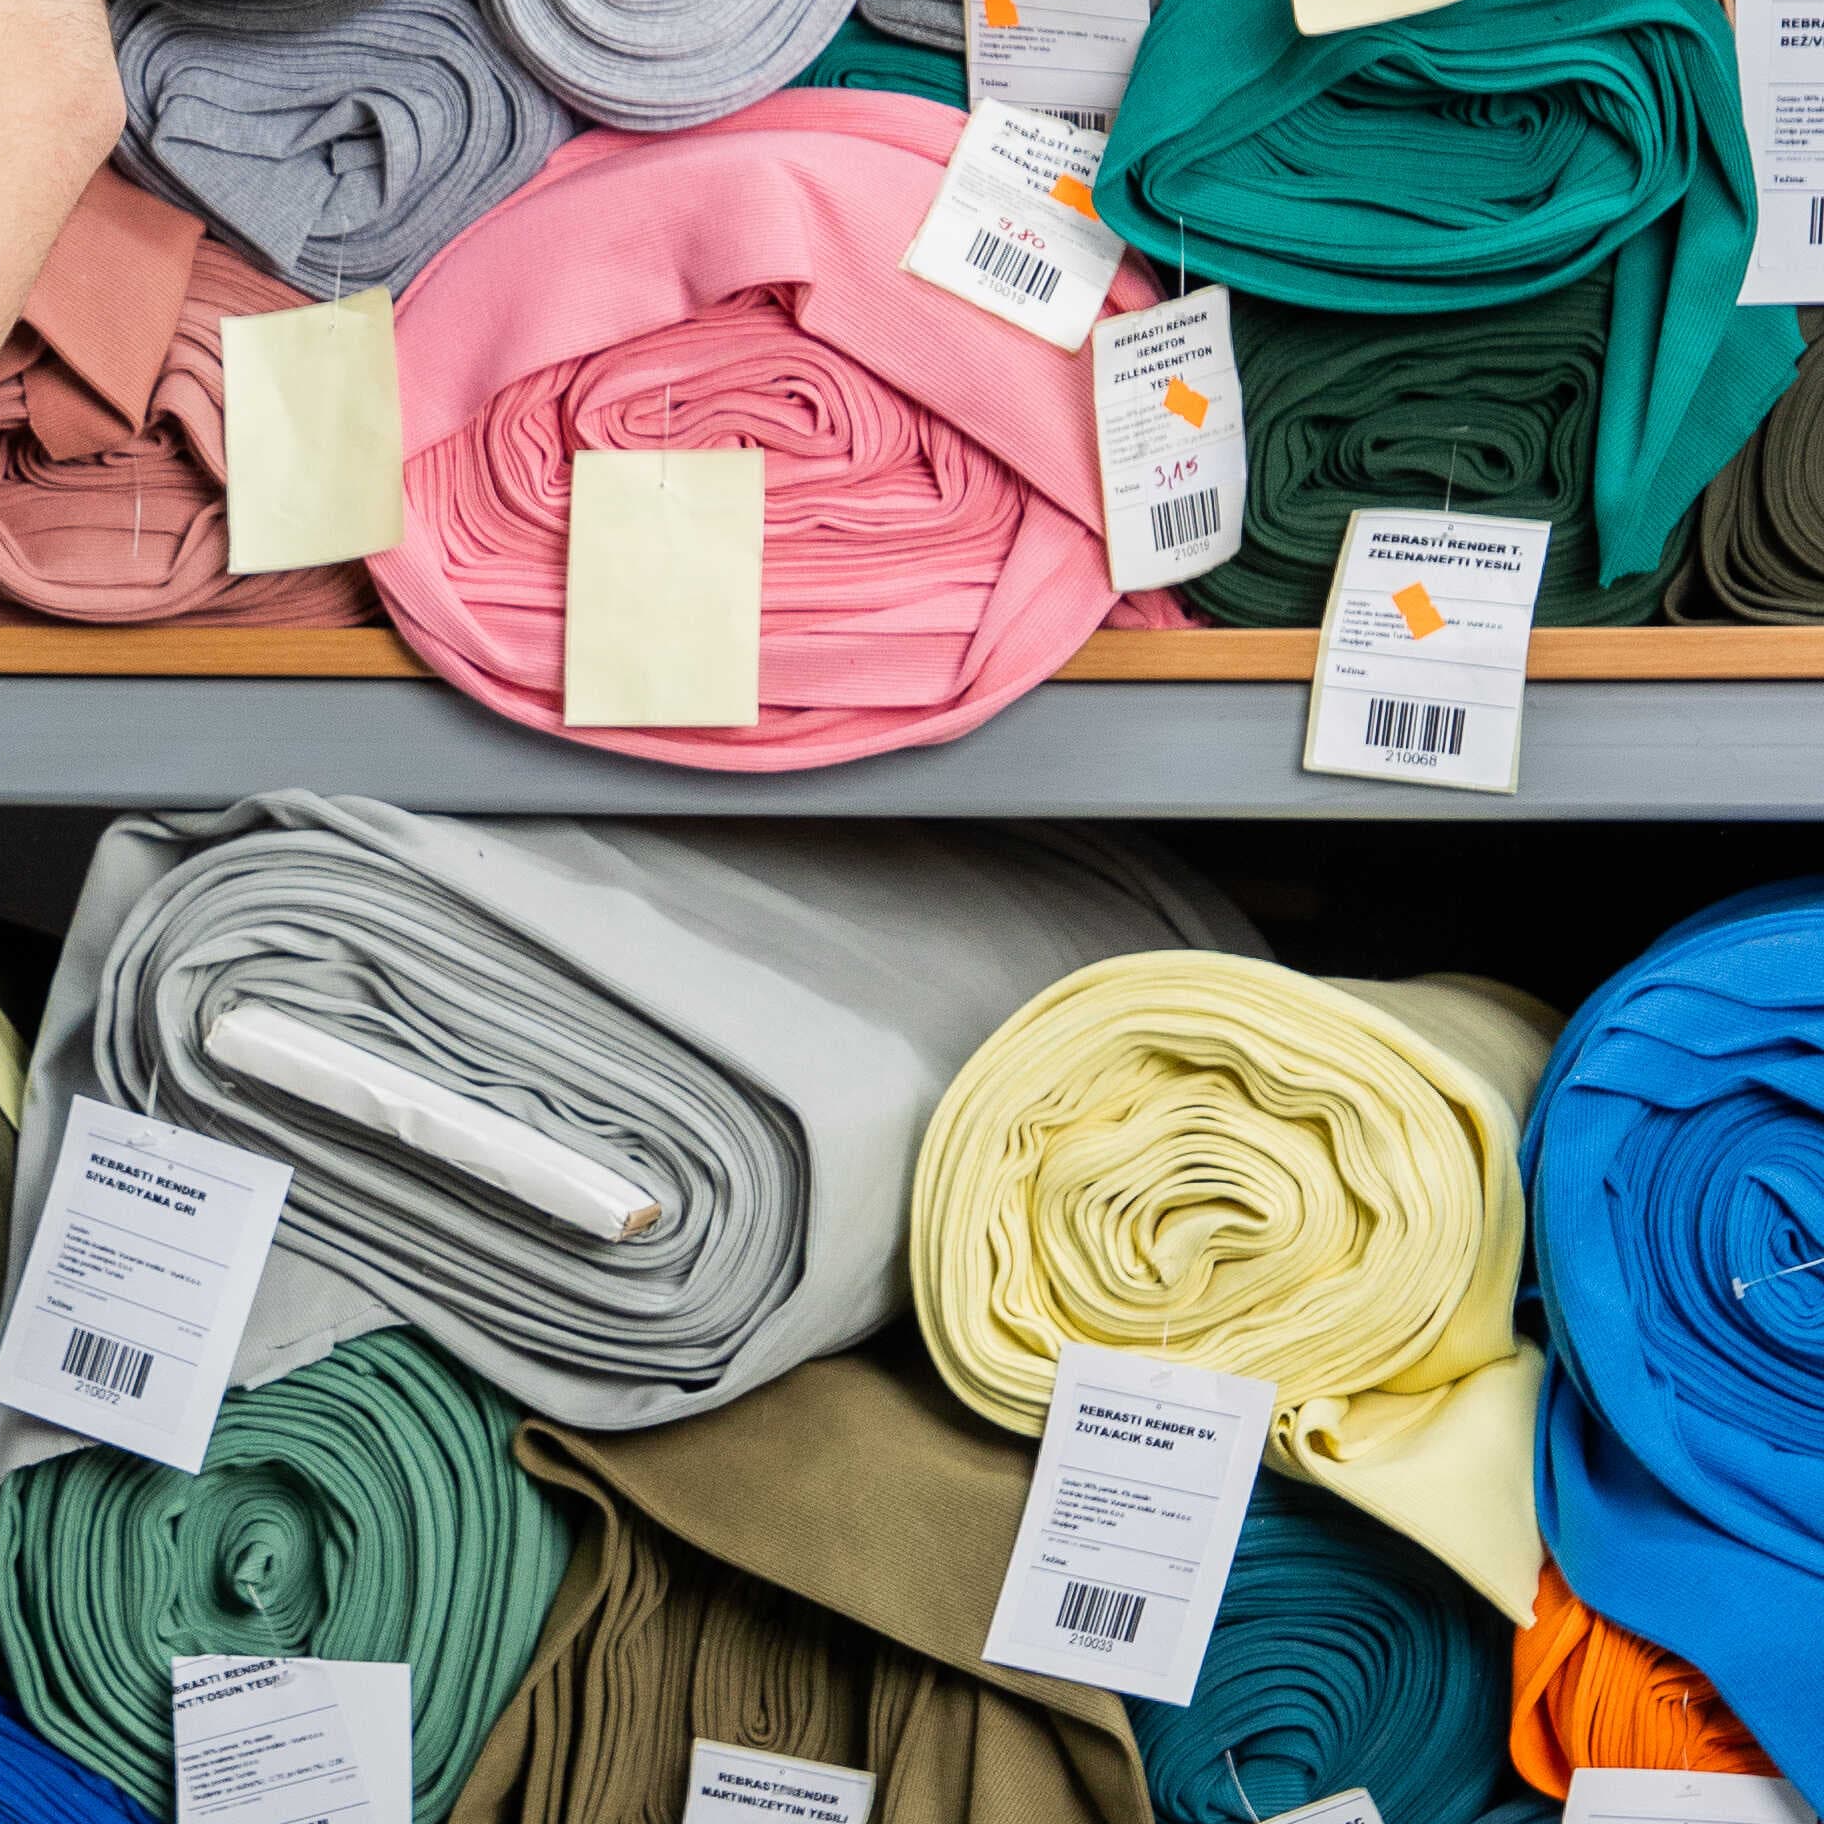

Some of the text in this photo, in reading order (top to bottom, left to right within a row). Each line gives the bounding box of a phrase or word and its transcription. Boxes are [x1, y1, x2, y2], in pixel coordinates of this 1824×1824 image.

[977, 275, 1028, 306] 210019
[1113, 311, 1209, 349] REBRASTI RENDER
[1136, 336, 1186, 359] BENETON
[1113, 345, 1213, 385] ZELENA/BENETTON
[1174, 539, 1211, 561] 210019
[1372, 532, 1523, 556] REBRASTI RENDER T.
[1367, 548, 1521, 572] ZELENA/NEFTI YESILI
[1385, 748, 1439, 768] 210068
[89, 1152, 208, 1203] REBRASTI RENDER
[85, 1170, 198, 1217] SIVA/BOYAMA GRI
[74, 1379, 122, 1406] 210072
[1074, 1420, 1176, 1452] ŽUTA/ACIK SARI
[1079, 1403, 1218, 1443] REBRASTI RENDER SV.
[1068, 1632, 1114, 1653] 210033
[223, 1658, 277, 1679] RENDER
[701, 1785, 806, 1817] MARTINI/ZEYTIN
